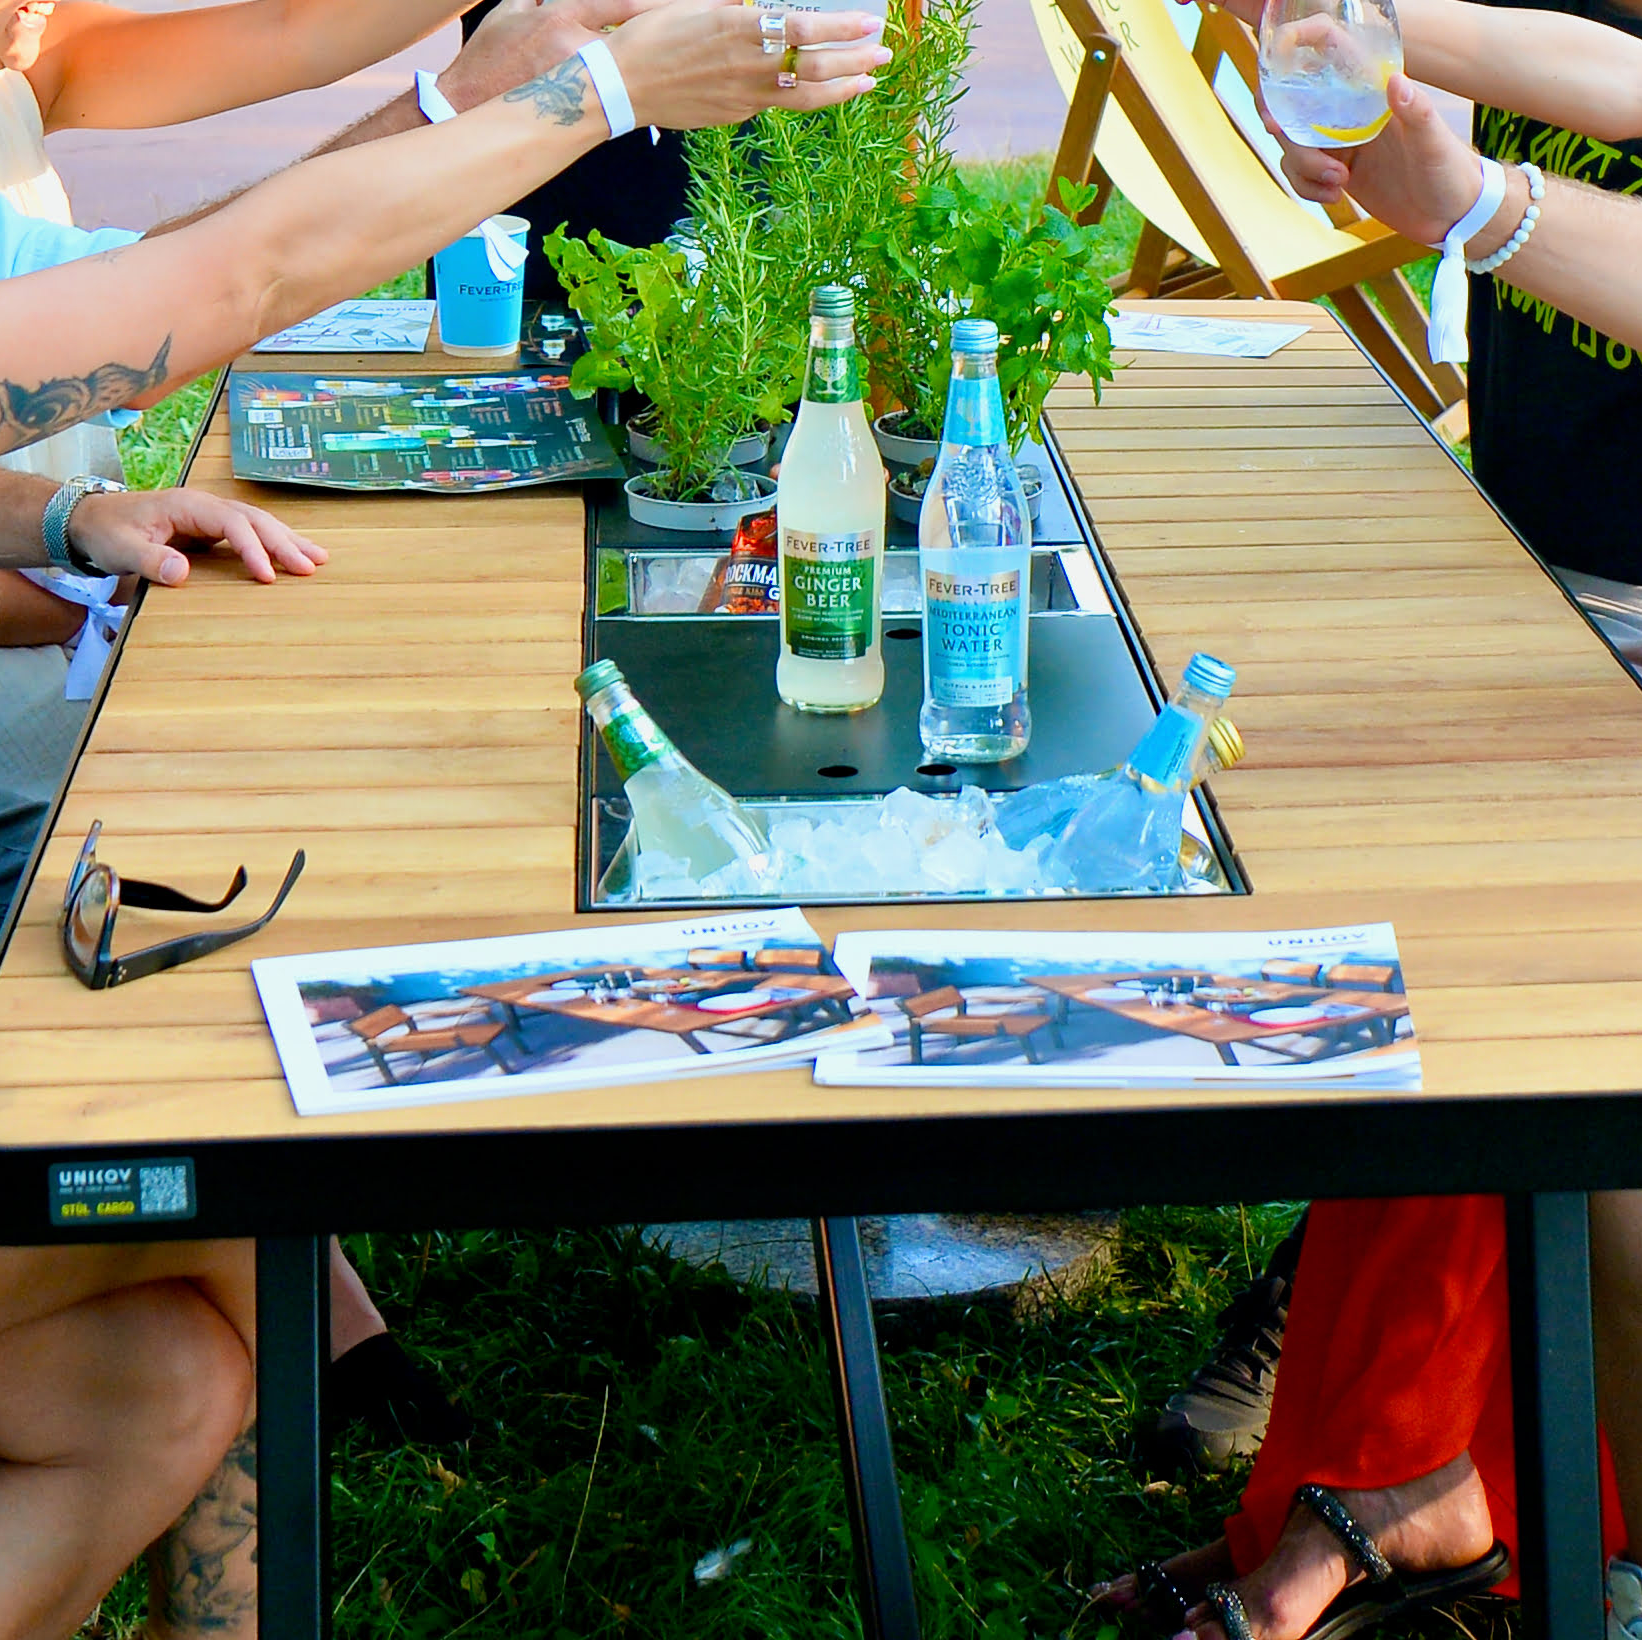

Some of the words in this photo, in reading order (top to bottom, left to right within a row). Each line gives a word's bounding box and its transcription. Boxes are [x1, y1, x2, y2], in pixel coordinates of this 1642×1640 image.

[786, 536, 871, 554] FEVER-TREE
[804, 566, 852, 576] PREMIUM
[794, 575, 863, 593] GINGER
[928, 578, 1017, 597] FEVER-TREE
[806, 593, 851, 608] BEER
[928, 605, 1017, 621] MEDITERRANEAN
[941, 621, 1001, 638] TONIC
[940, 637, 1003, 654] WATER
